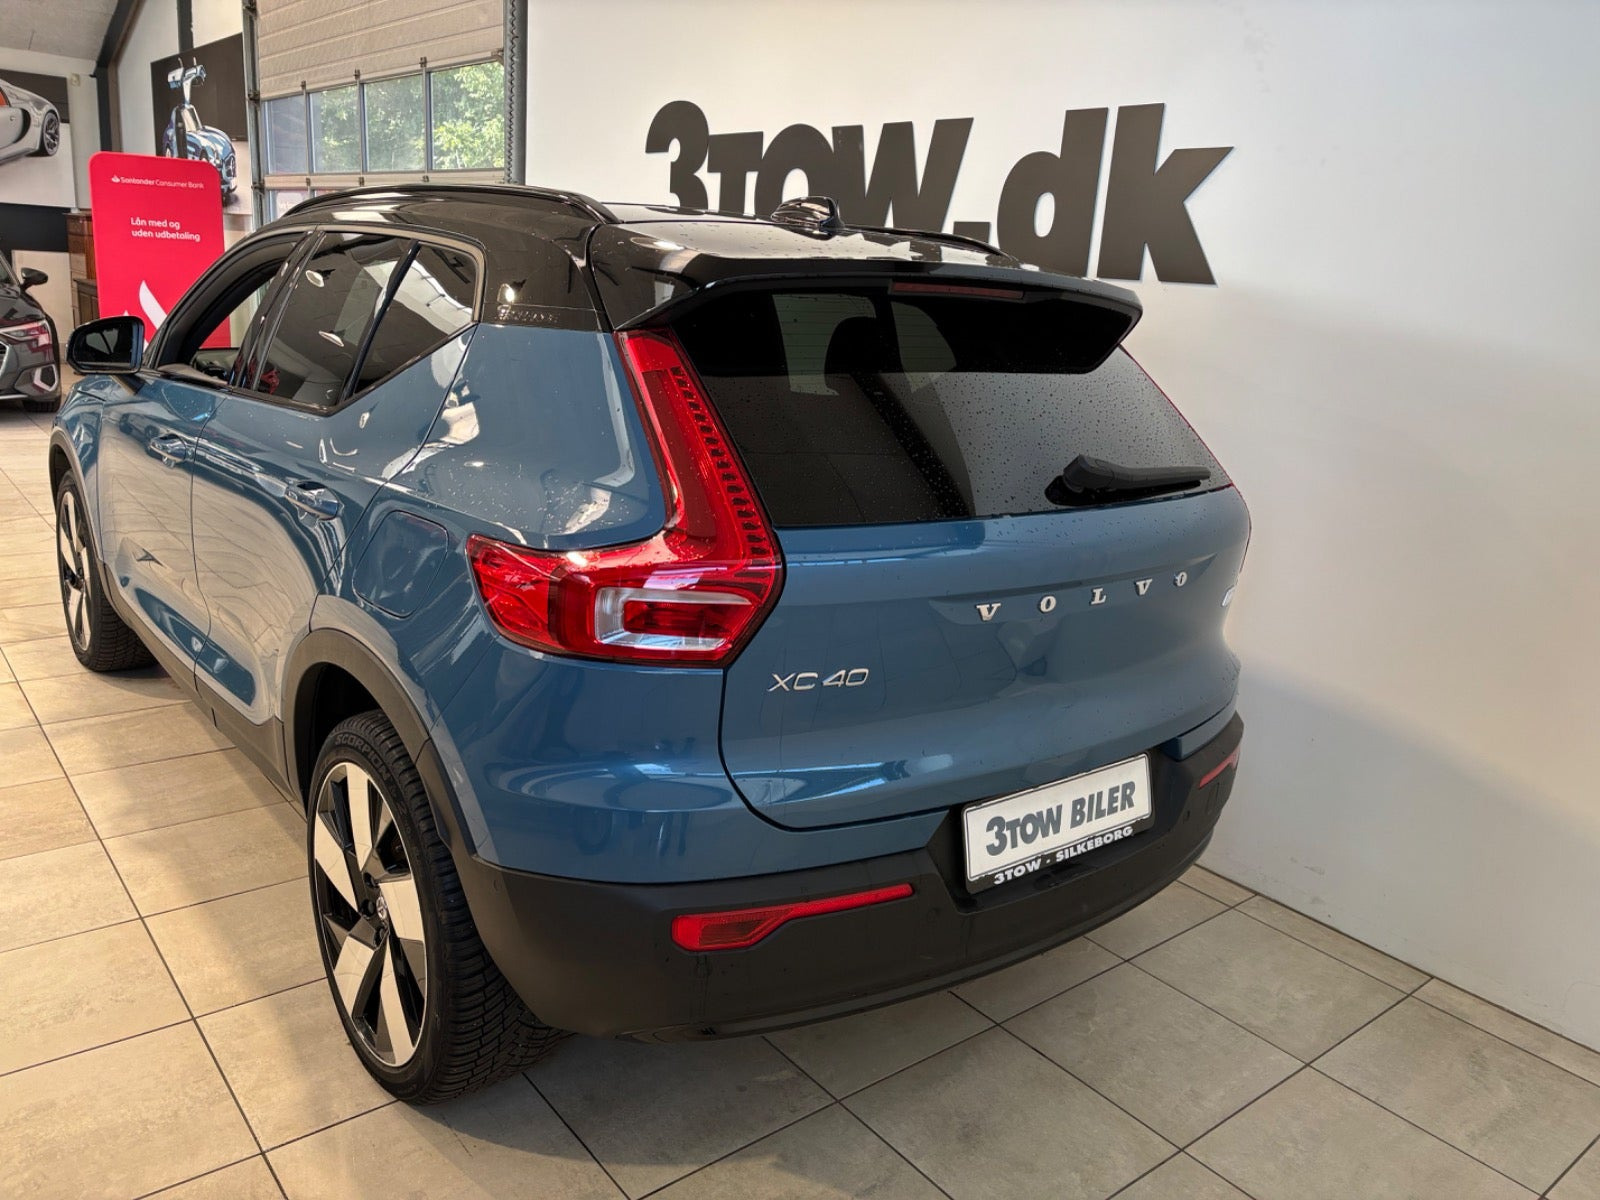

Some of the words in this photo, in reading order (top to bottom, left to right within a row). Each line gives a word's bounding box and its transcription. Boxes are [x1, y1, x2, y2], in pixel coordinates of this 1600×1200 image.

[120, 176, 155, 185] Santander
[155, 179, 187, 188] Consumer
[188, 181, 204, 189] Bank
[130, 217, 147, 226] Lån
[148, 219, 168, 228] med
[168, 221, 181, 231] og
[131, 228, 154, 238] uden
[155, 230, 201, 243] udbetaling
[976, 571, 1188, 621] VOLVO
[985, 804, 1063, 857] 3TOW
[1069, 780, 1136, 829] BILER
[993, 858, 1042, 886] 3TOW
[1055, 826, 1134, 863] SILKEBORG
